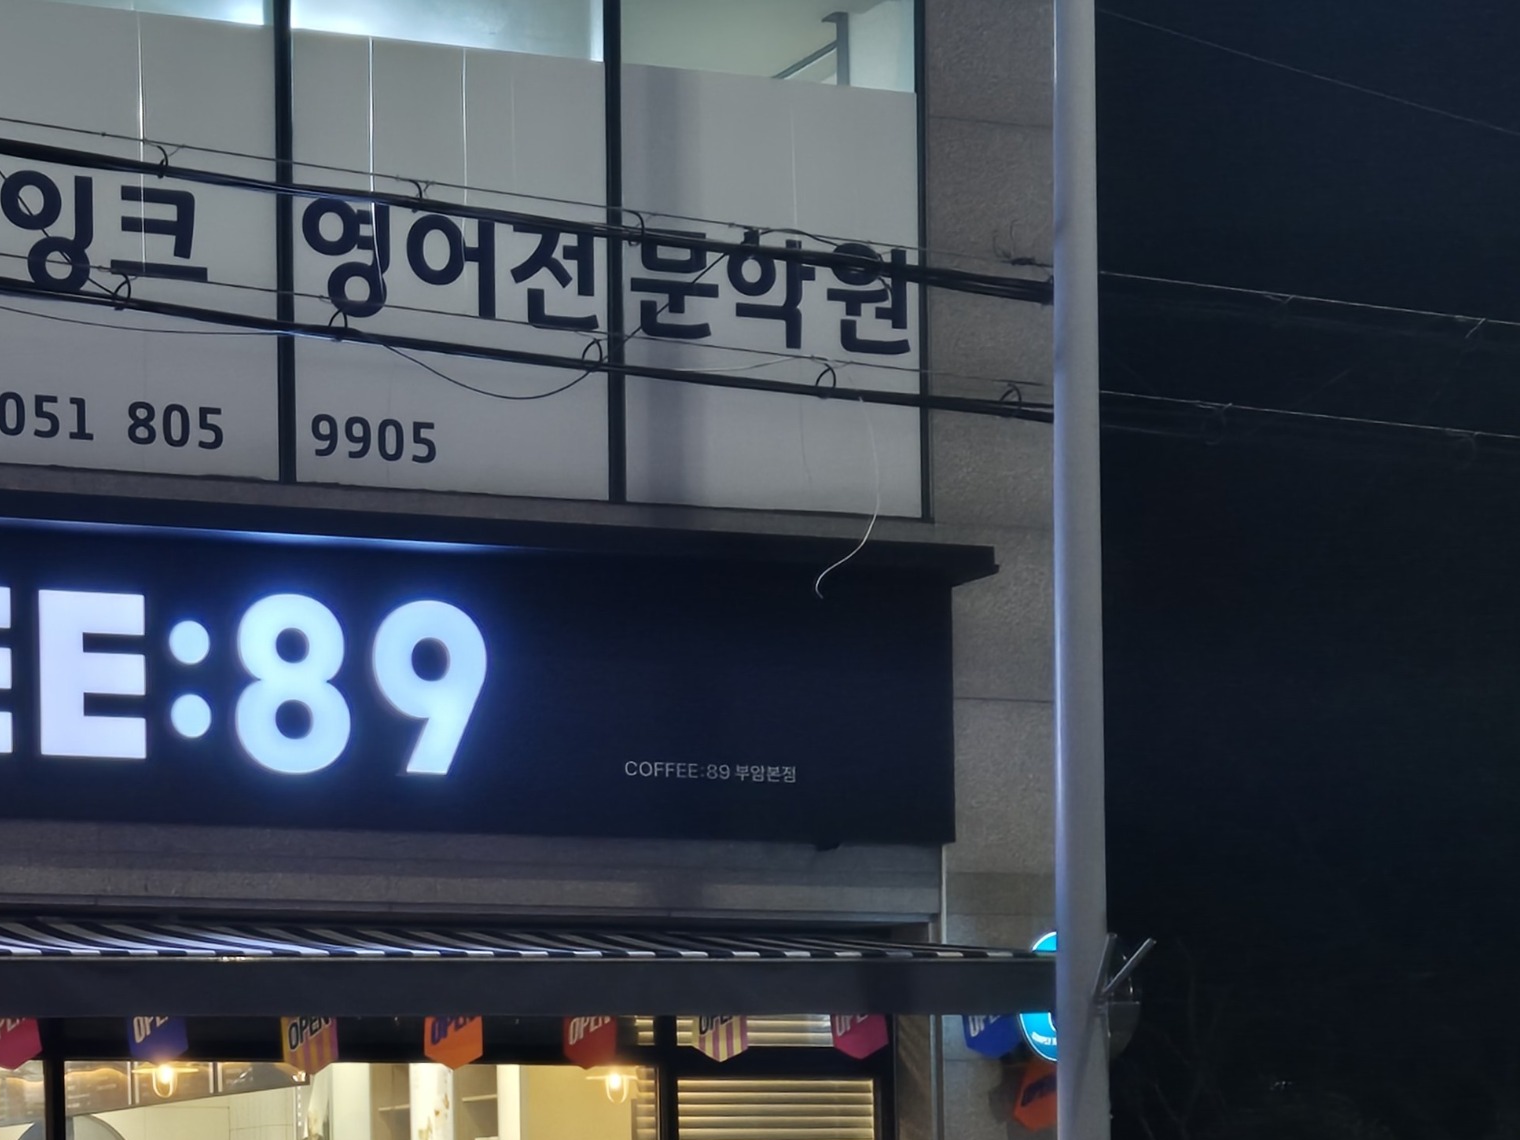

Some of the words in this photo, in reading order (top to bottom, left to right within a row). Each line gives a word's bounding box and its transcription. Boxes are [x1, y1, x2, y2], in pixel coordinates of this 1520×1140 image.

[0, 170, 208, 291] 잉크
[127, 401, 224, 450] 805
[311, 413, 437, 464] 9905
[624, 761, 730, 780] COFFEE:89
[735, 764, 797, 783] 부암본점
